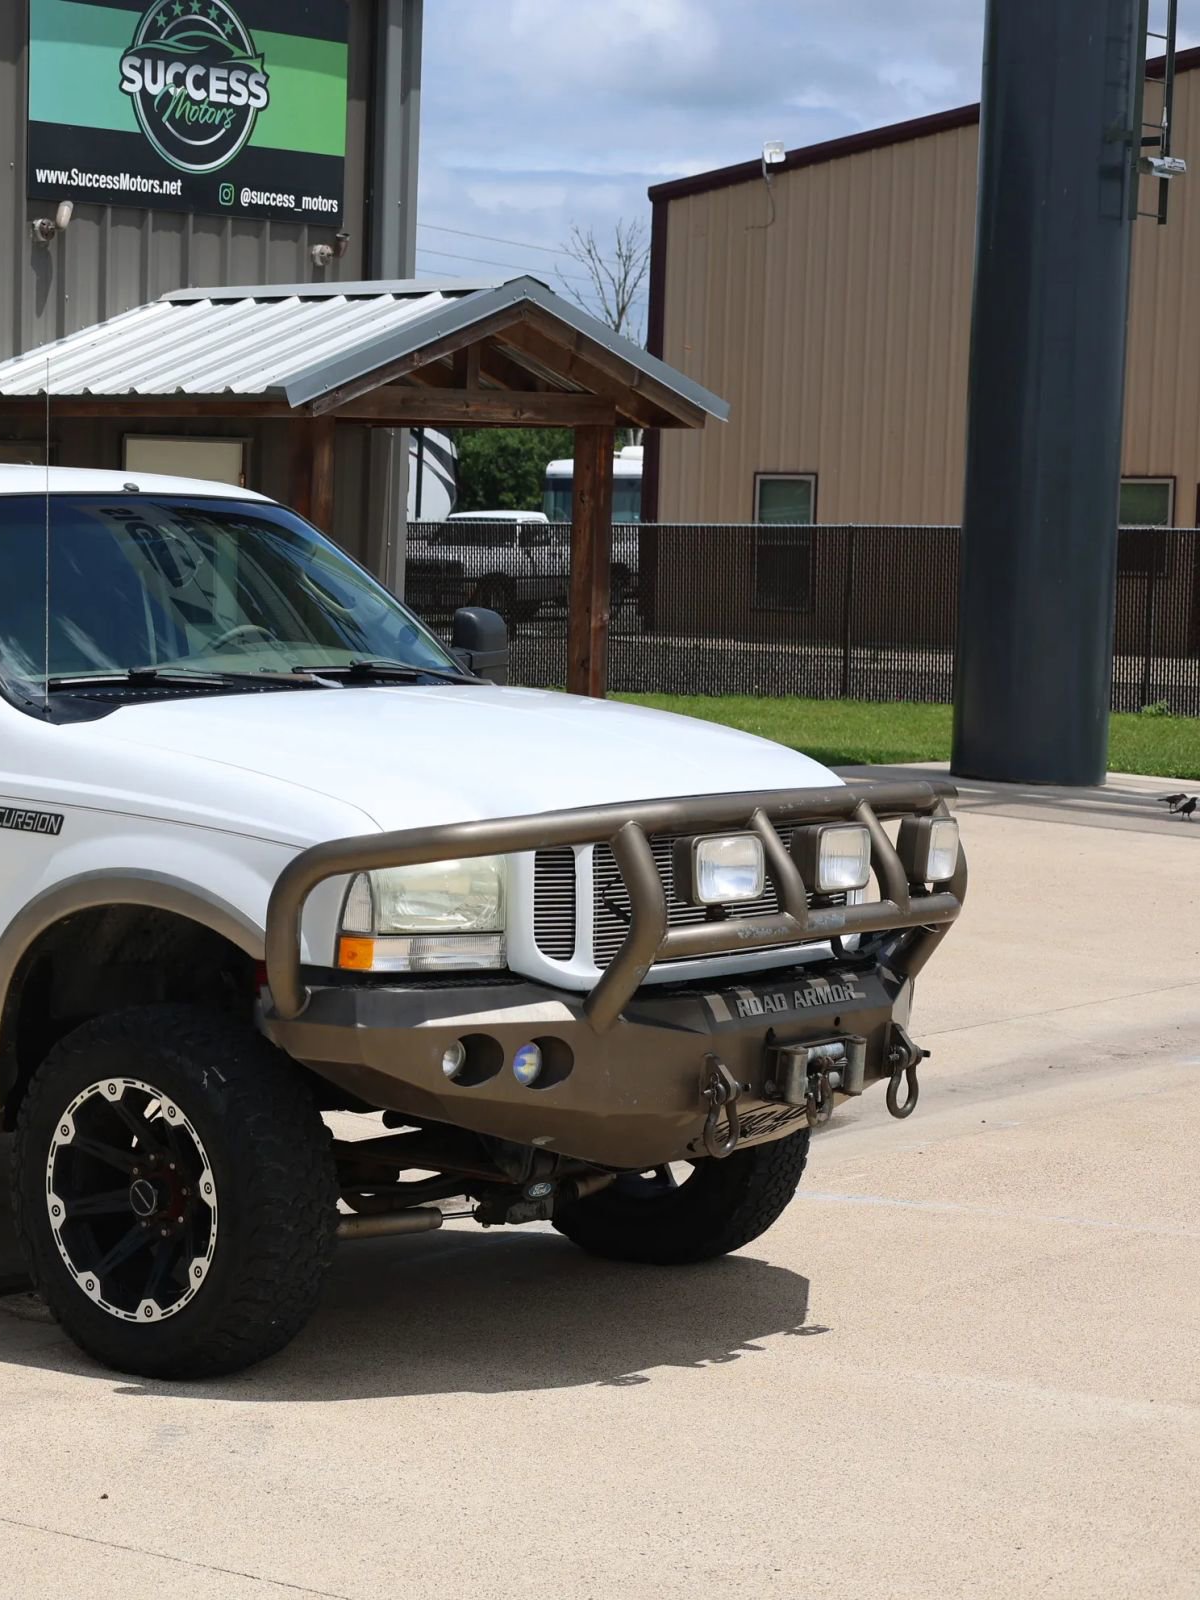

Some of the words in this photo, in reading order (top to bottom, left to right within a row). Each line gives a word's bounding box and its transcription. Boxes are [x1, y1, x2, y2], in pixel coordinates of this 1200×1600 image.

[121, 55, 268, 109] SUCCESS
[154, 82, 237, 129] Motors
[35, 168, 183, 195] www.SuccessMotors.net
[240, 187, 339, 213] @success_motors
[736, 993, 789, 1018] ROAD
[793, 982, 856, 1009] ARMOR
